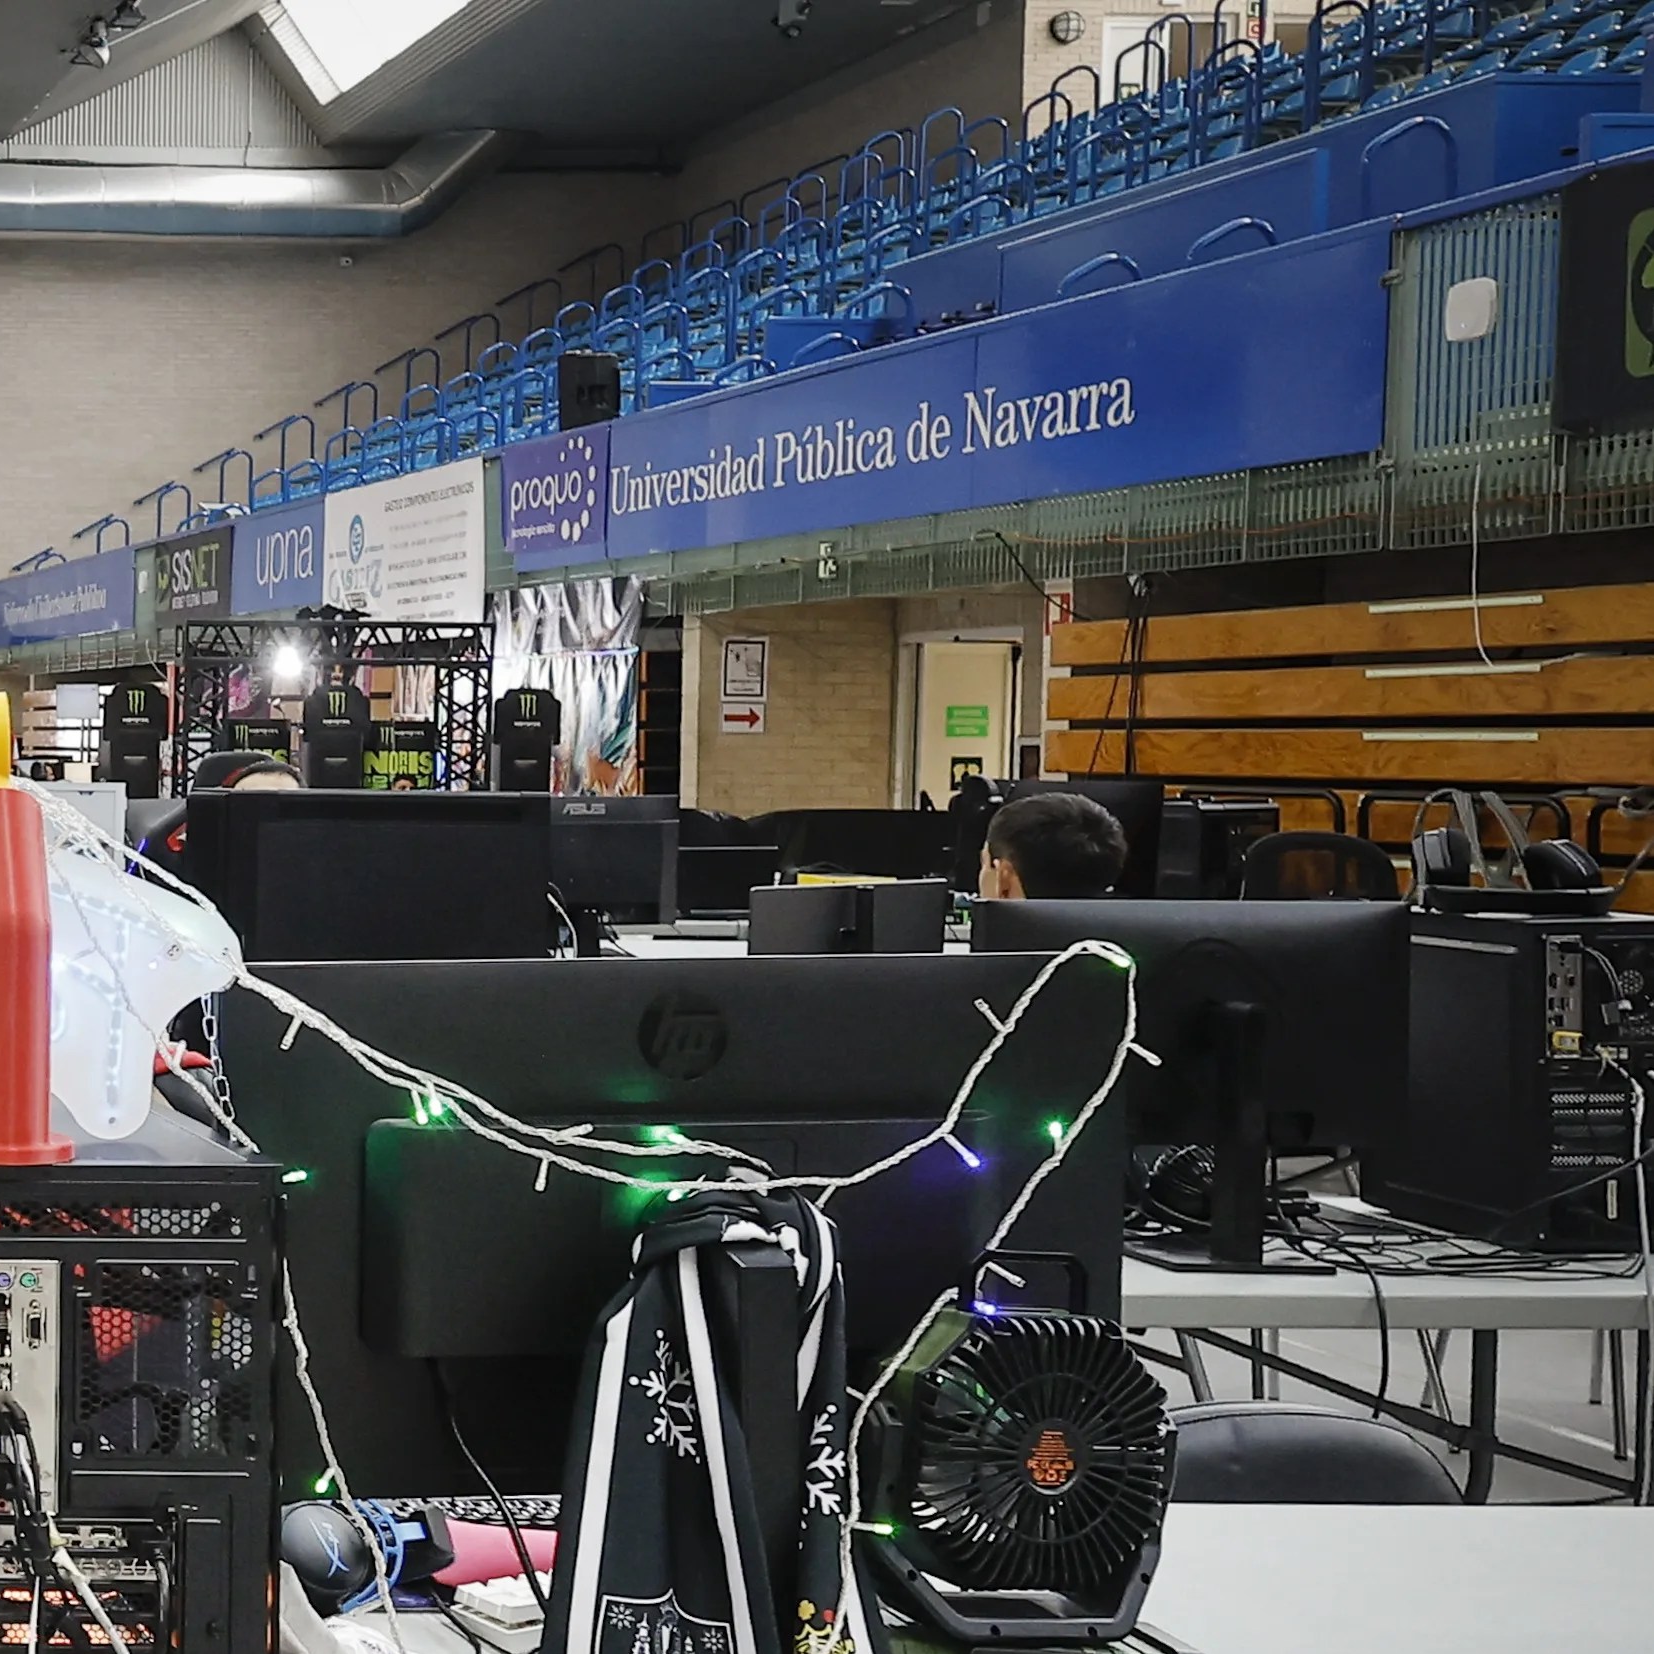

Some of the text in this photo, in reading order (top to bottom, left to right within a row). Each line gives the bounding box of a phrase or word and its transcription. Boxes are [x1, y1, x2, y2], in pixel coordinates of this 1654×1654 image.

[611, 377, 1136, 516] Universidad Pública de Navarra
[510, 469, 582, 522] proquo
[256, 526, 314, 599] upna
[563, 803, 605, 815] ASUS
